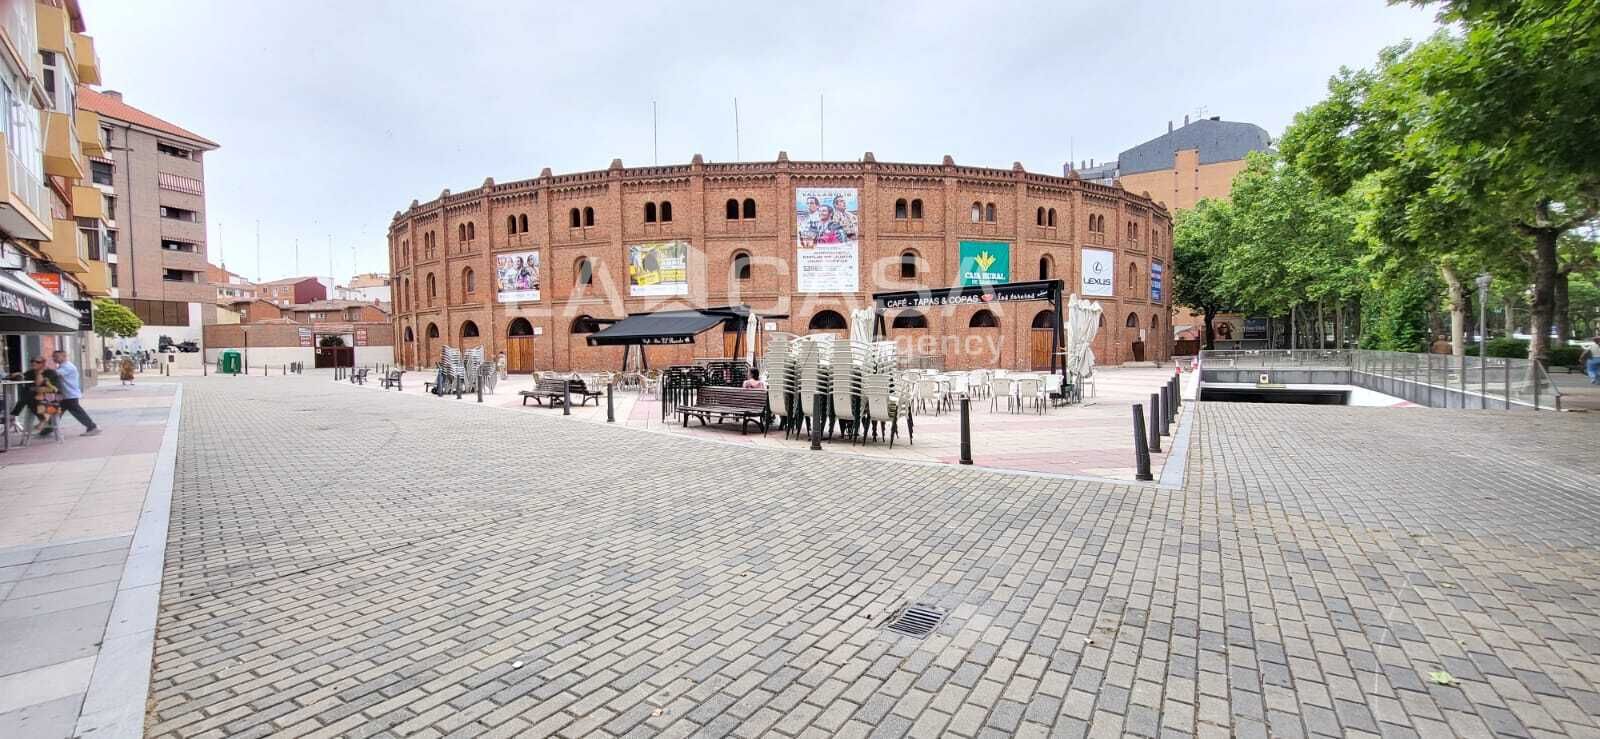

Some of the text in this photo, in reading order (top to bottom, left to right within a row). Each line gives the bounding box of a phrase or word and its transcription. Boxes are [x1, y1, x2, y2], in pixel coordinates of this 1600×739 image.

[1083, 275, 1112, 286] LEXUS
[887, 300, 908, 309] CAFÉ
[914, 297, 940, 307] TAPAS
[950, 295, 979, 305] COPAS
